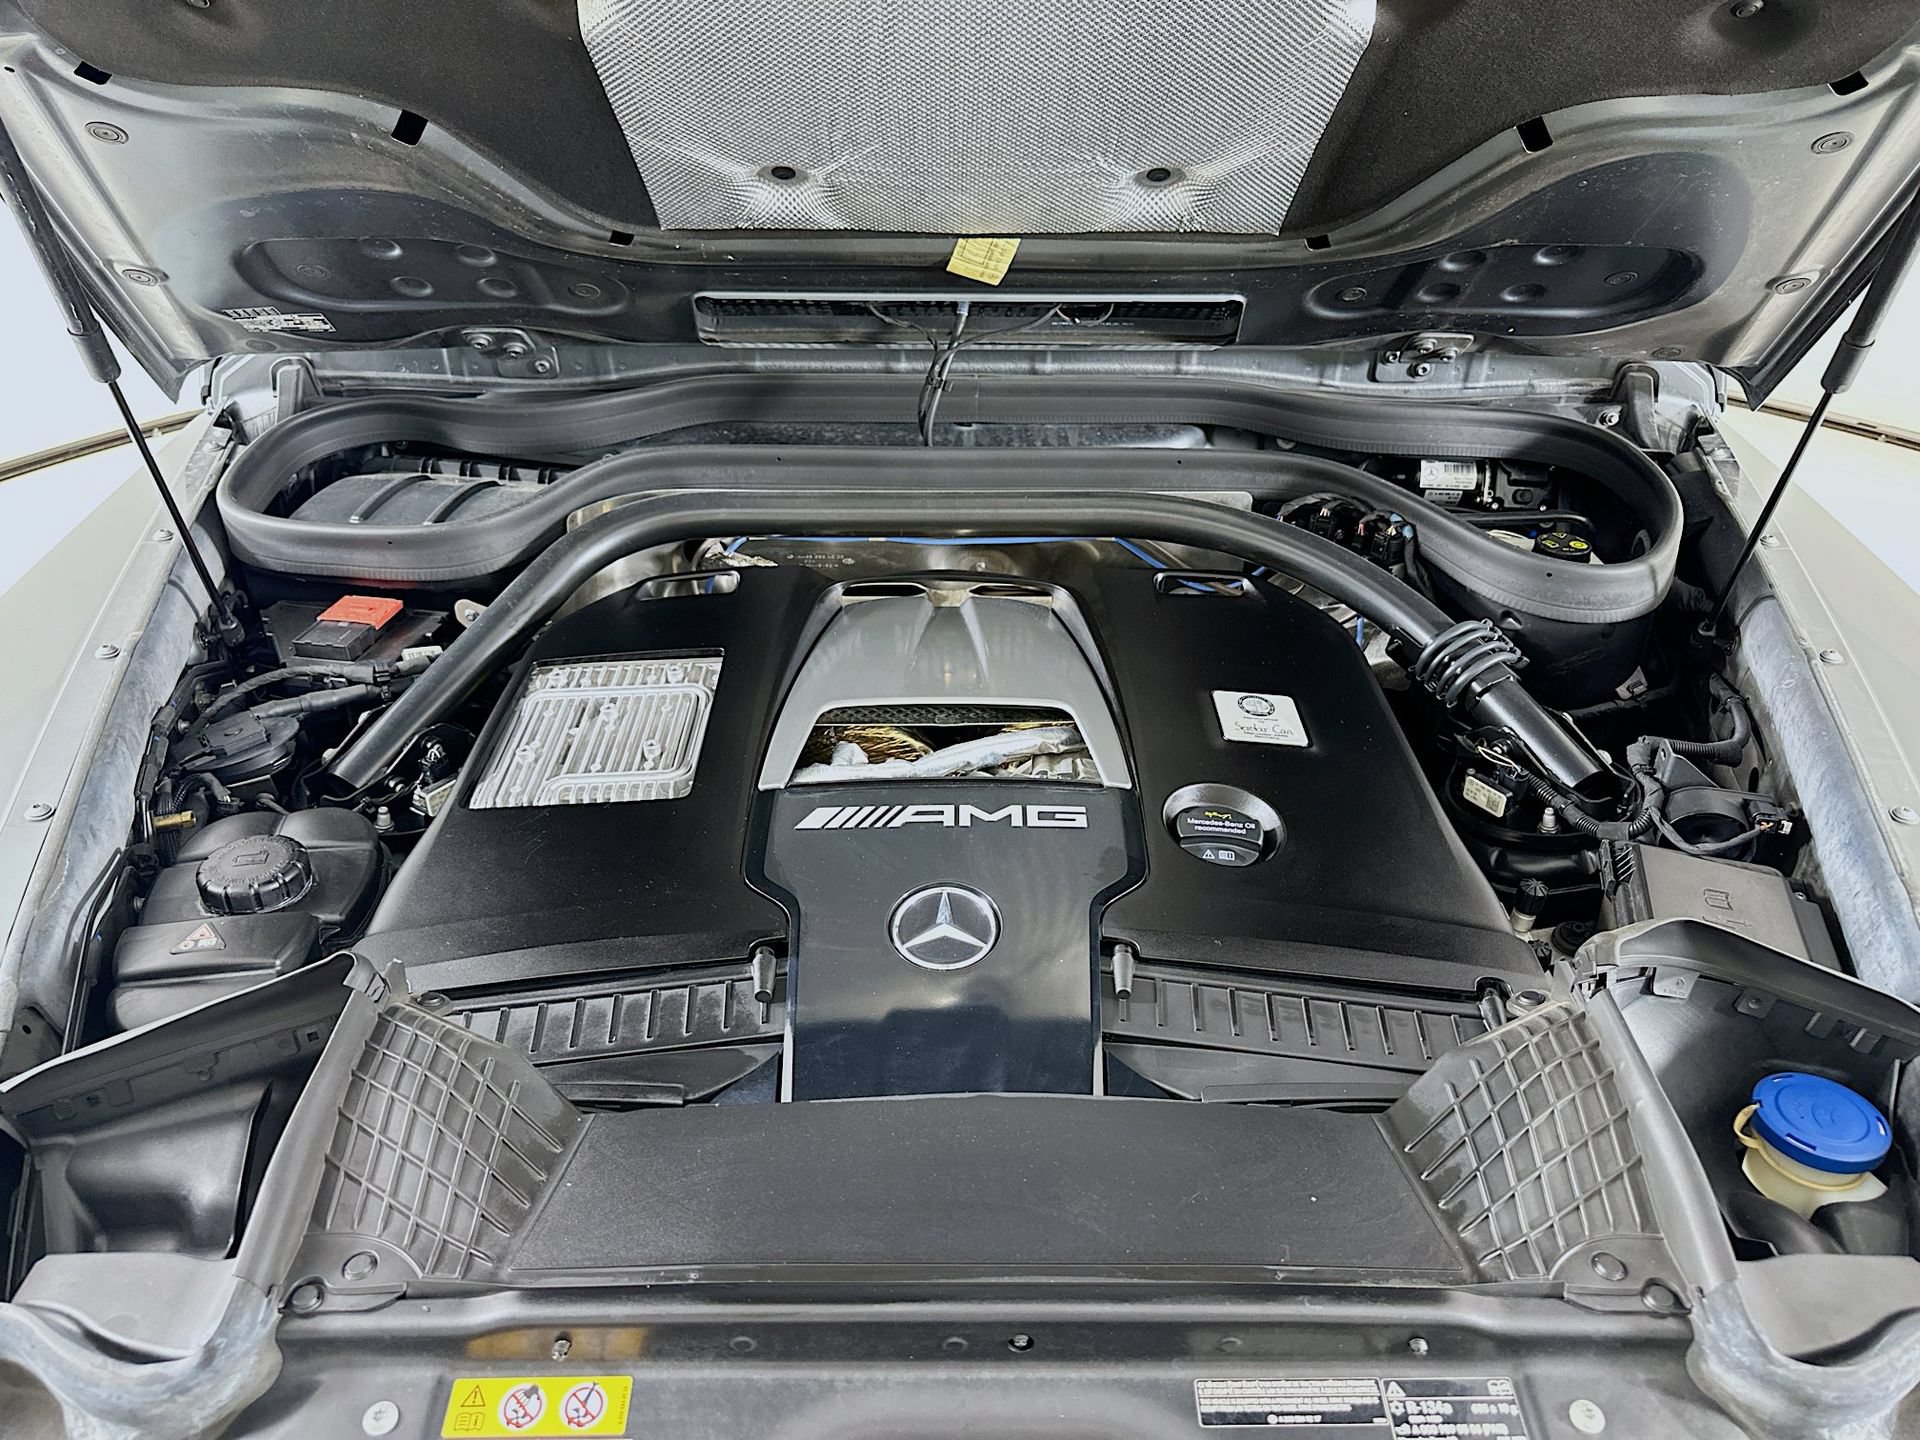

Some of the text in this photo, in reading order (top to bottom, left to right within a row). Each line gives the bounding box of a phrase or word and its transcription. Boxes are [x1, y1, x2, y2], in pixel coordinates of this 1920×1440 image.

[887, 804, 1088, 829] AMG
[1187, 817, 1244, 829] Mercedes-Benz
[1194, 824, 1247, 835] recommended
